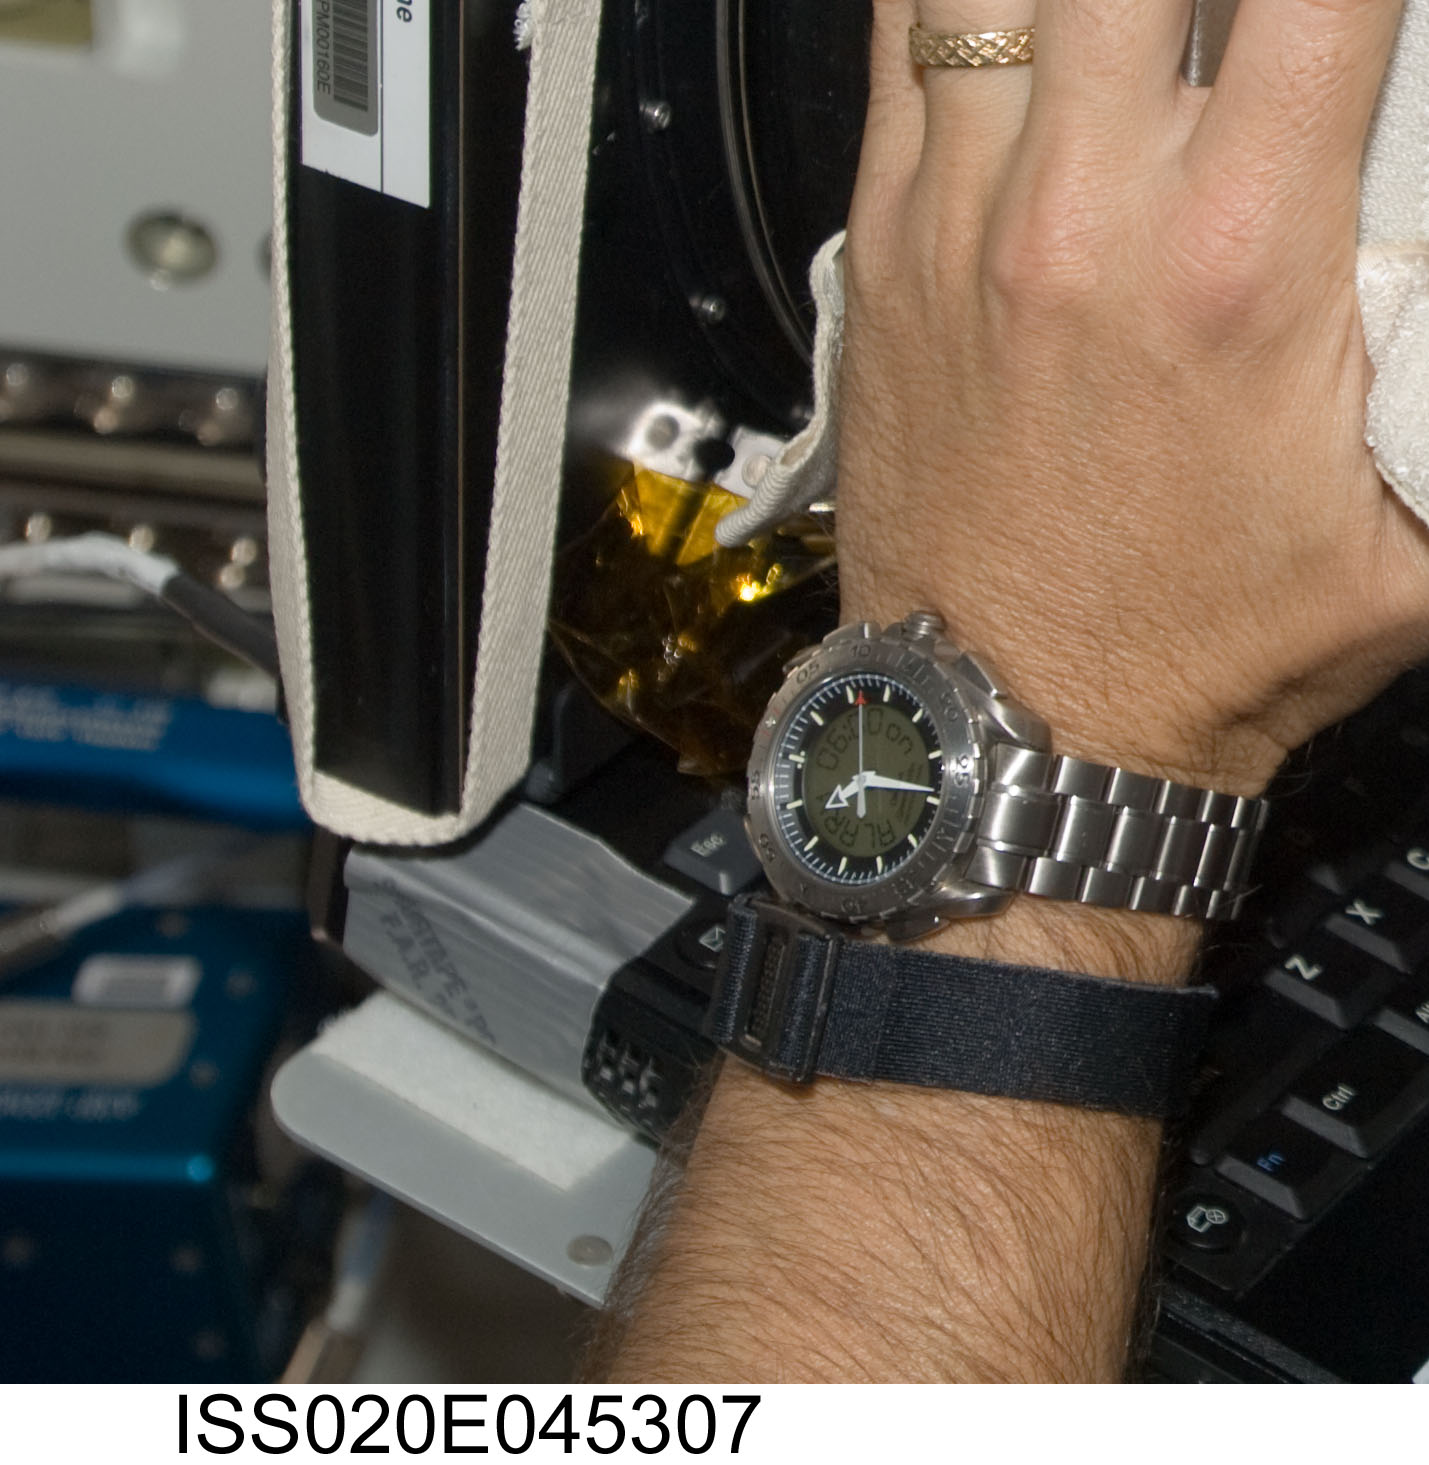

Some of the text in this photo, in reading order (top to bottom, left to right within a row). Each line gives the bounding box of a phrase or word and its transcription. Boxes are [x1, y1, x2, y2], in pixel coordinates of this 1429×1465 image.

[1345, 897, 1384, 926] X
[1284, 953, 1323, 980] Z
[1321, 1083, 1356, 1111] Ctrl
[1256, 1151, 1286, 1173] Fn
